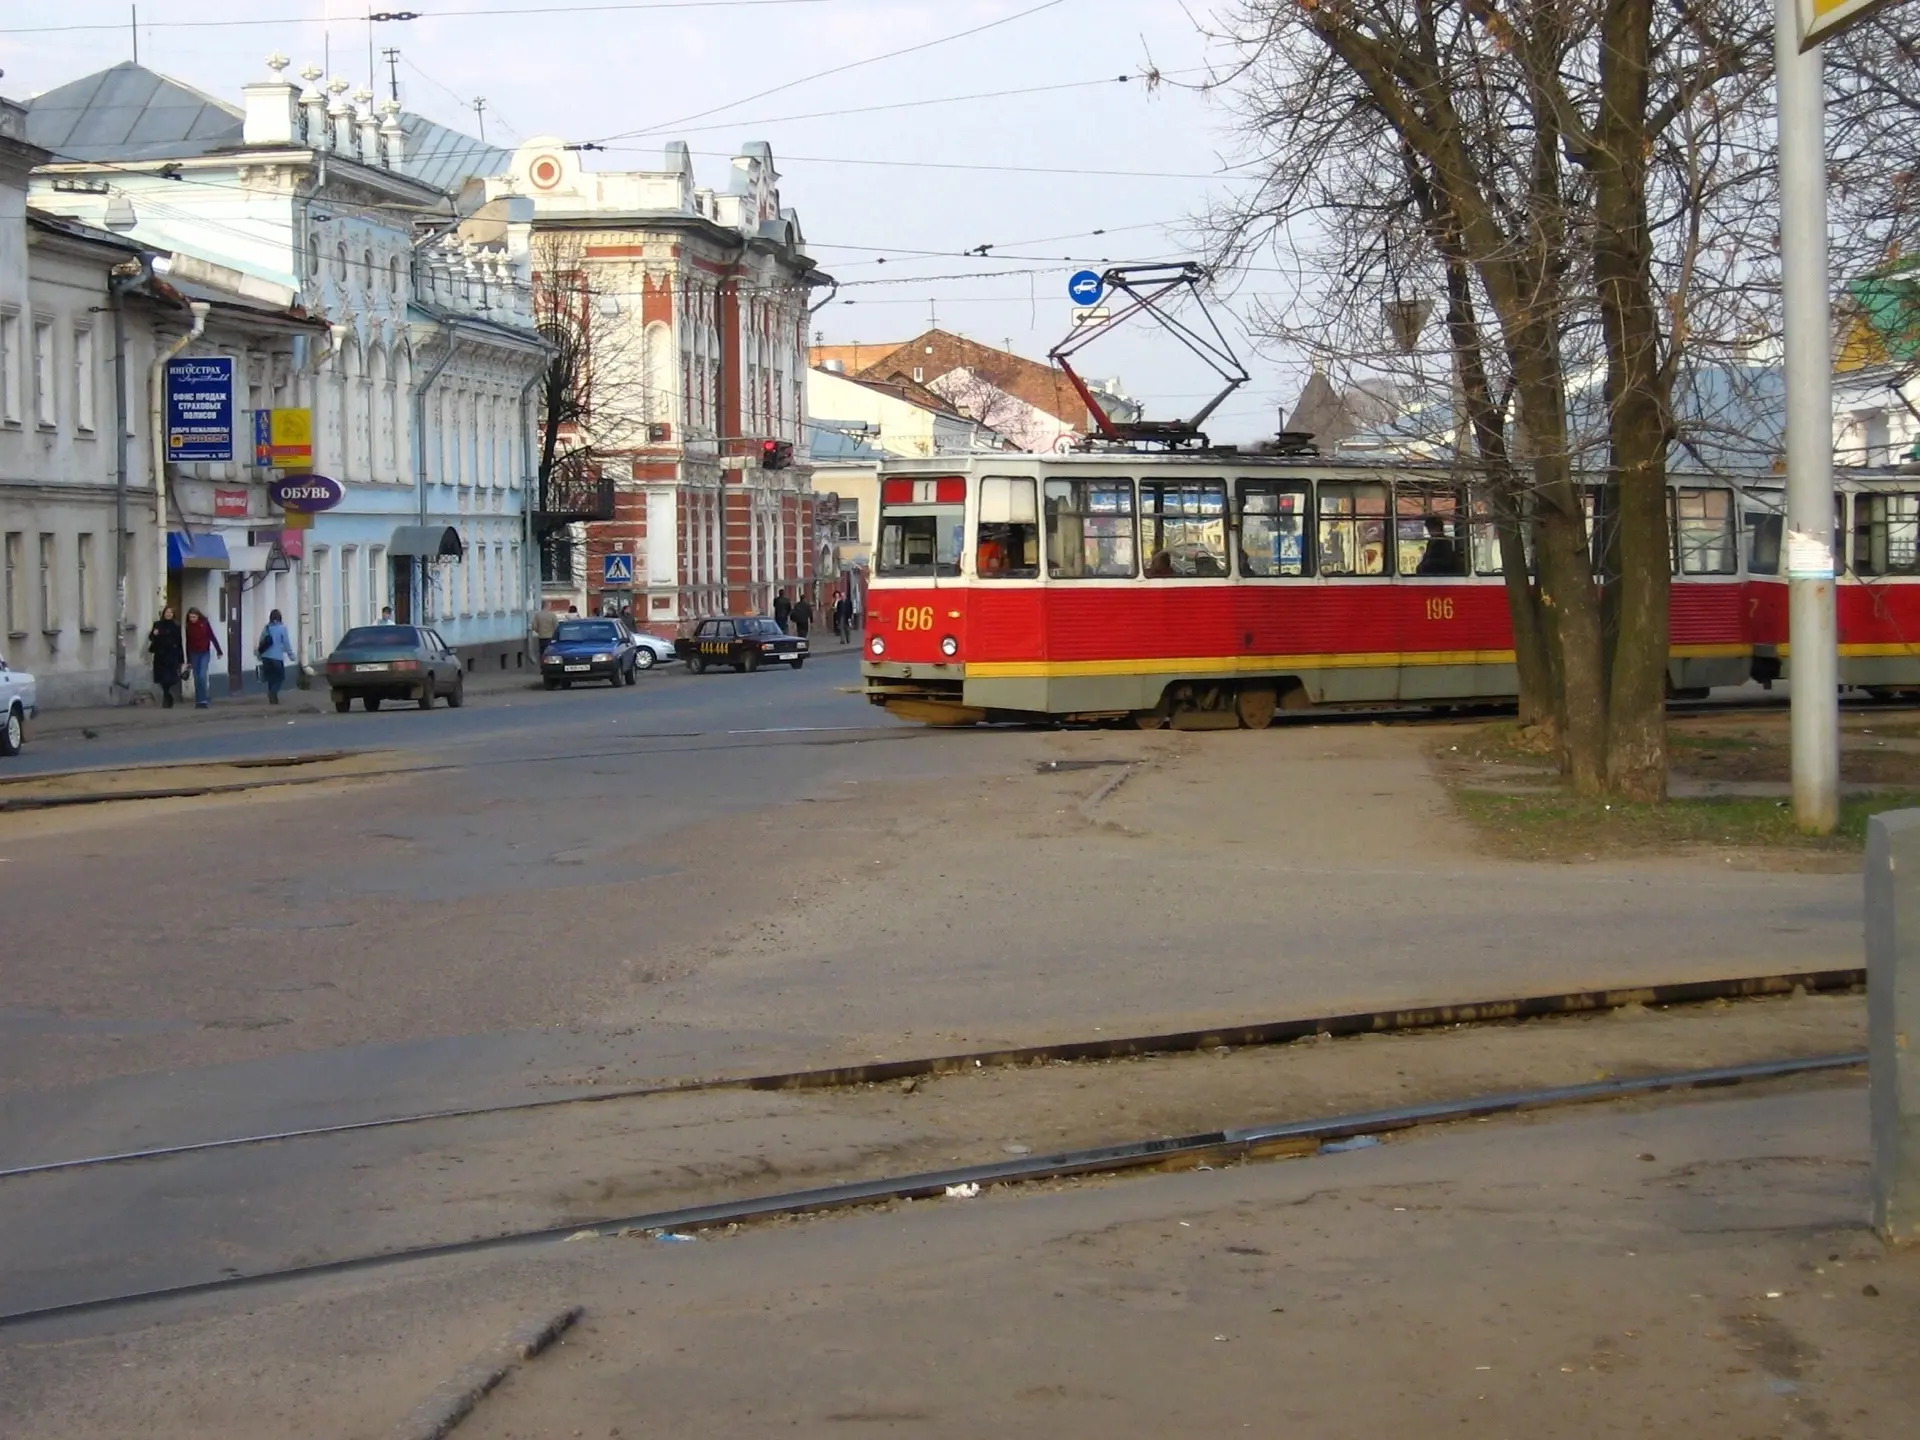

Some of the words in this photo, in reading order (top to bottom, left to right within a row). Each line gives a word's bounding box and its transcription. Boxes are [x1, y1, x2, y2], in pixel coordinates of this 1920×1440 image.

[169, 363, 221, 375] ИНГОССТРАХ
[173, 393, 195, 401] ОФИС
[196, 393, 227, 402] ПРОДАЖ
[178, 402, 222, 410] СТРАХОВЫХ
[183, 411, 217, 420] ПОЛИСОВ
[280, 486, 330, 499] ОБУВЬ
[1425, 597, 1454, 620] 196
[896, 606, 934, 632] 196
